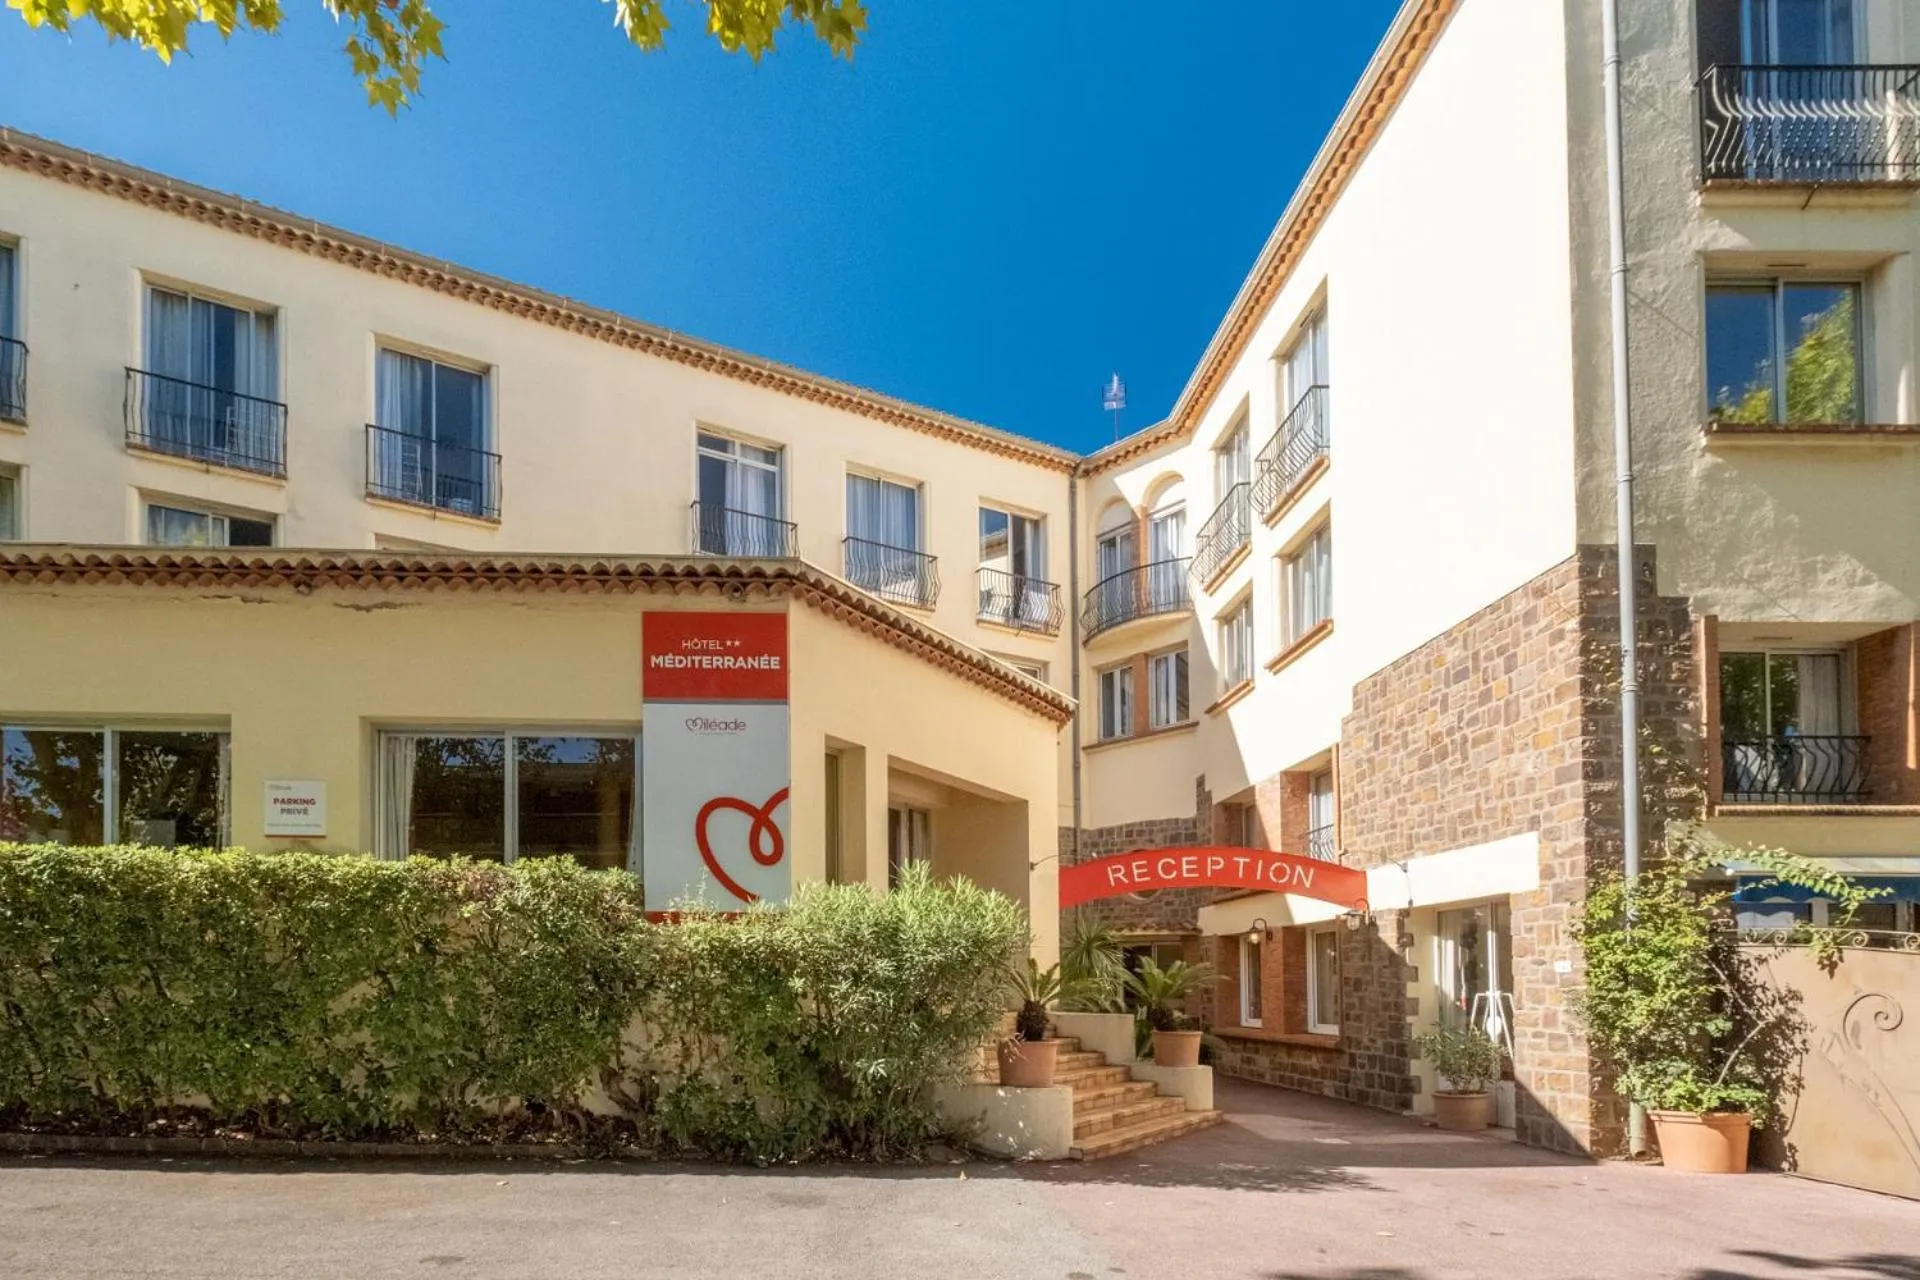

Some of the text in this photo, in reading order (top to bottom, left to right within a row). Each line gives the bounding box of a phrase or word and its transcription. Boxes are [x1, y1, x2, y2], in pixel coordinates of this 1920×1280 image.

[681, 638, 723, 650] HÔTEL
[651, 652, 781, 669] MÉDITERRANÉE
[272, 797, 317, 806] PARKING
[1107, 856, 1314, 889] RECEPTION
